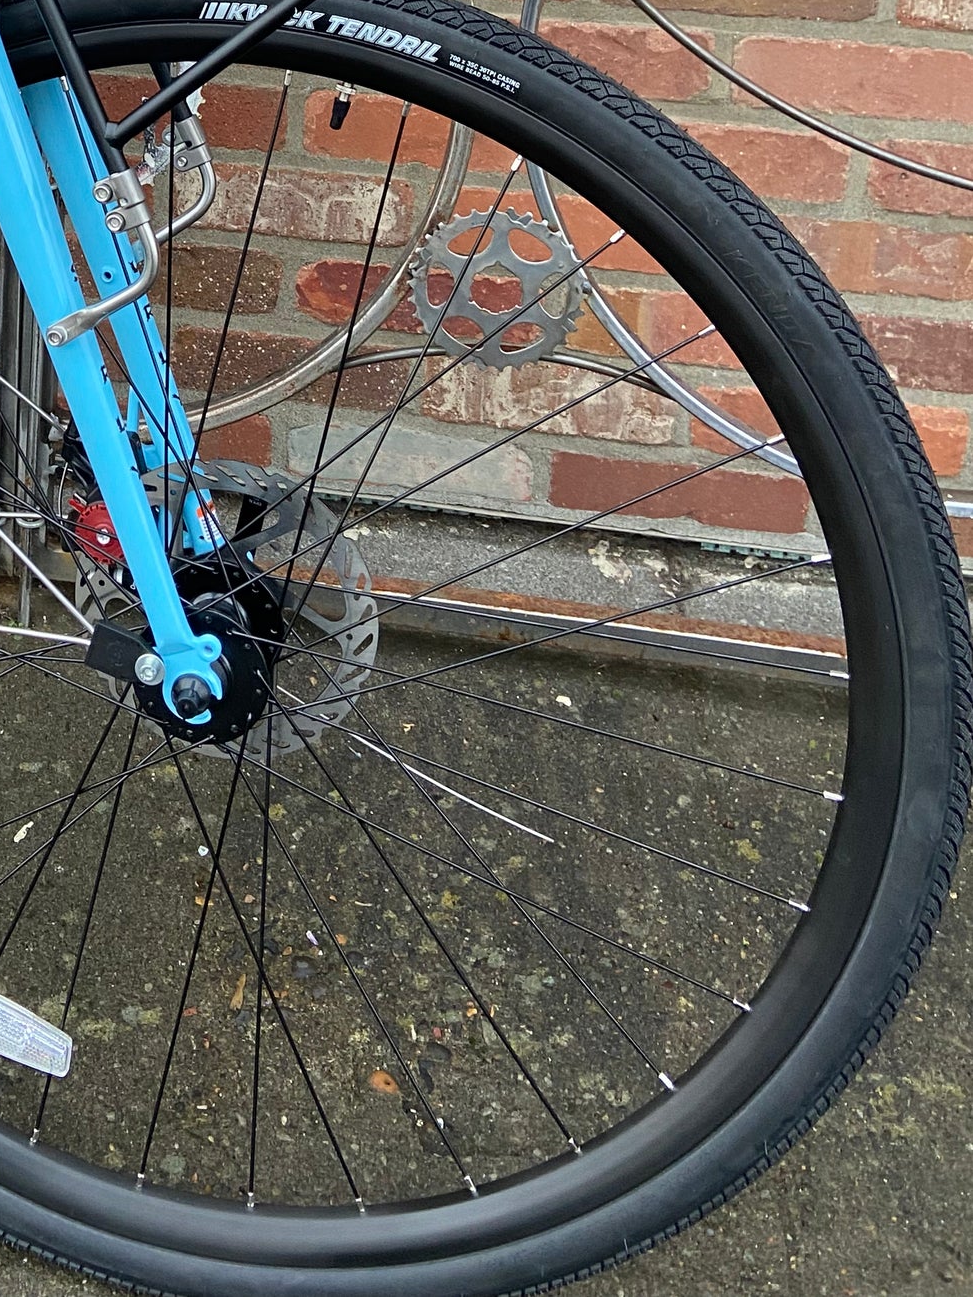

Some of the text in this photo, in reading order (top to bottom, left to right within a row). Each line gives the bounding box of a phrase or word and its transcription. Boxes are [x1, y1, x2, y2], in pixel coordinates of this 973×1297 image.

[226, 1, 441, 64] KWCK TENDRIL
[449, 60, 465, 71] WIRE
[465, 66, 482, 78] BEAD
[449, 53, 461, 63] 700
[466, 60, 479, 70] 35C
[479, 65, 496, 78] 30TPI
[497, 73, 521, 89] CASING
